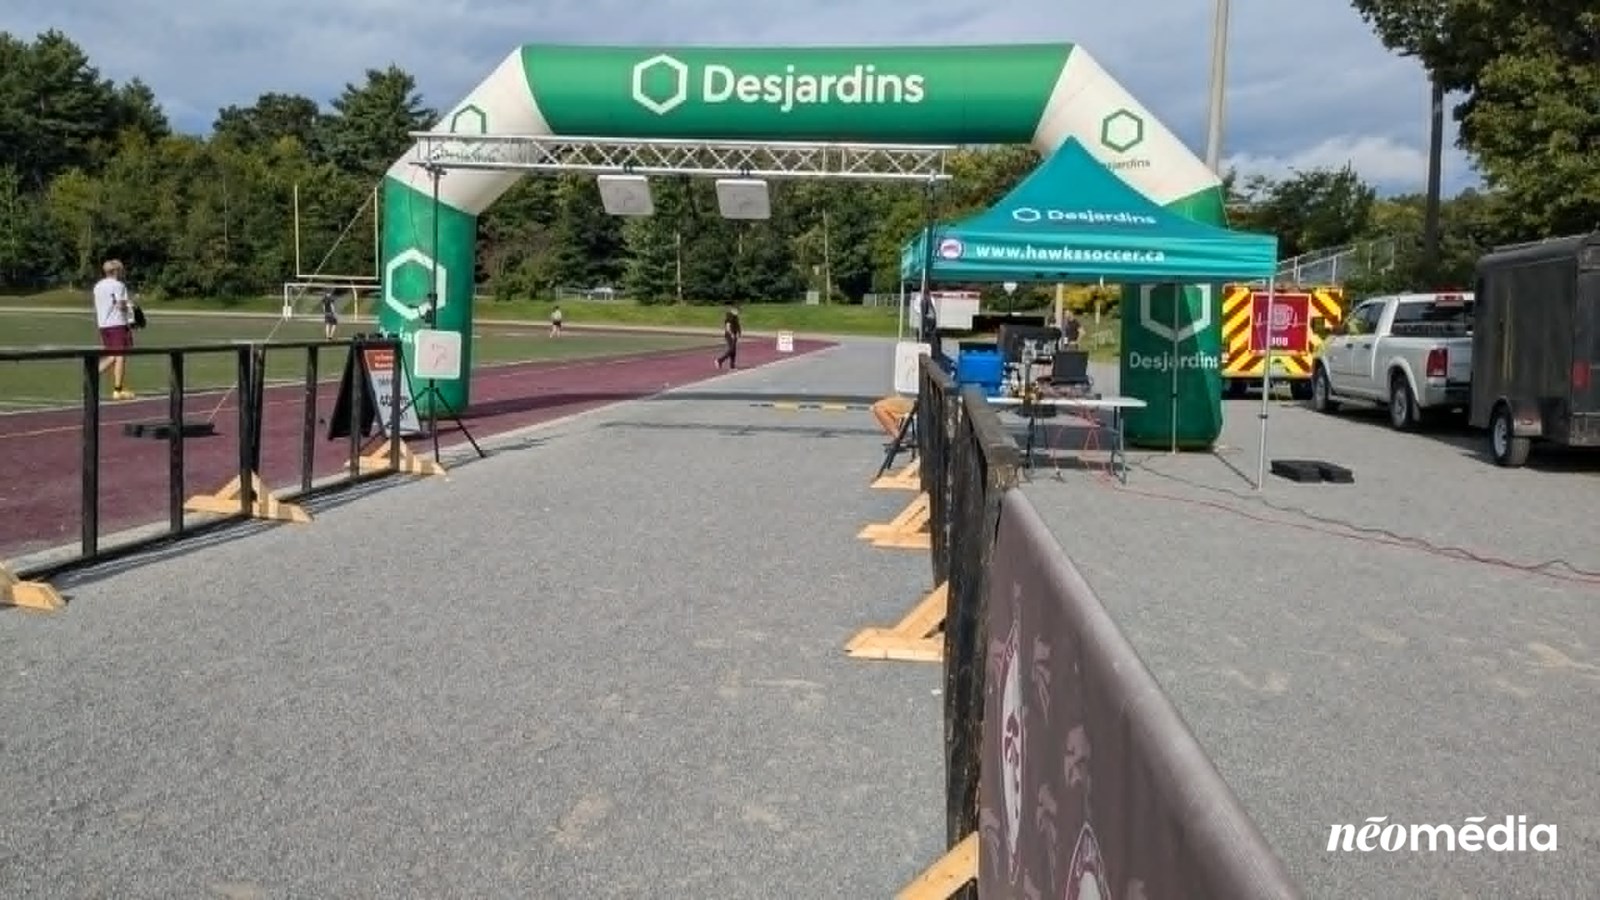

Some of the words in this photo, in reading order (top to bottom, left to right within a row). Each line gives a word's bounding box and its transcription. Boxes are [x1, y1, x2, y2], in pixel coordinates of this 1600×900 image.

[703, 64, 925, 113] Desjardins
[1048, 209, 1157, 224] Desjardins
[976, 243, 1165, 263] www.hawkssoccer.ca
